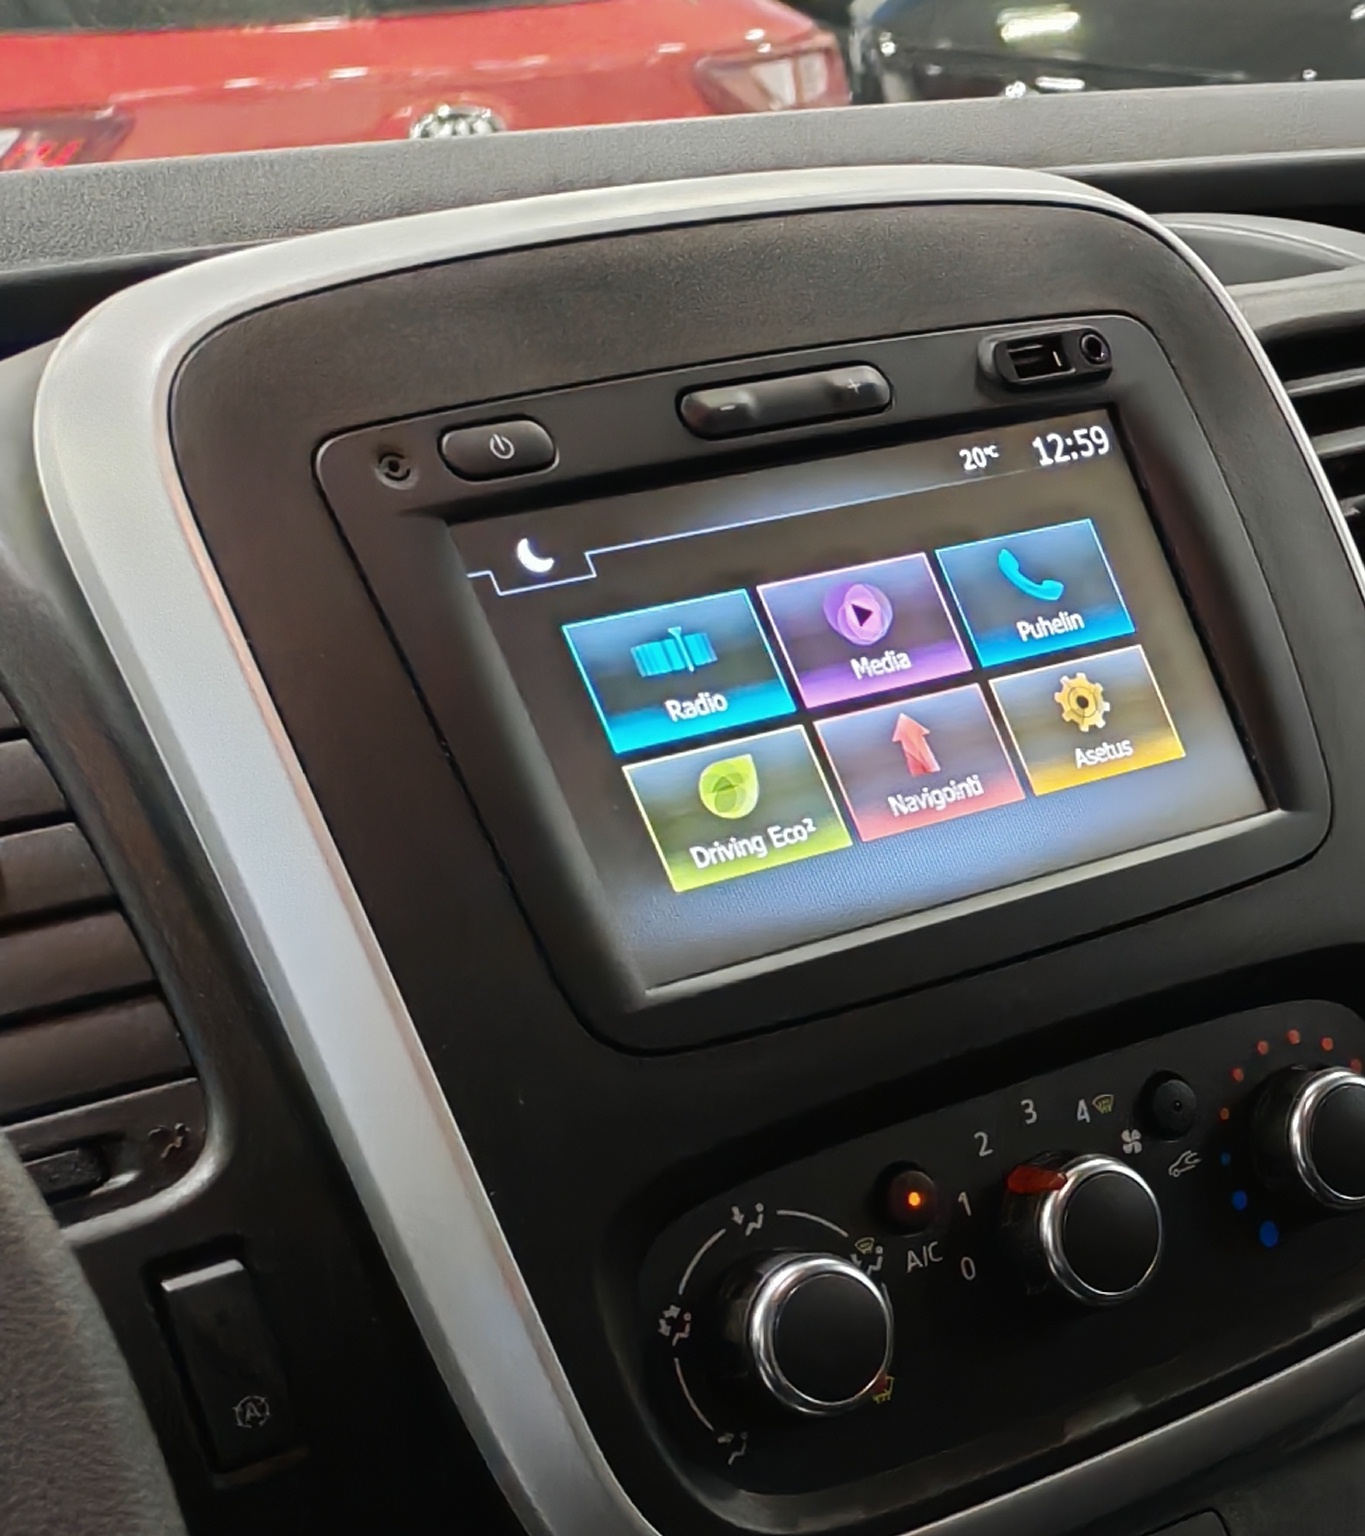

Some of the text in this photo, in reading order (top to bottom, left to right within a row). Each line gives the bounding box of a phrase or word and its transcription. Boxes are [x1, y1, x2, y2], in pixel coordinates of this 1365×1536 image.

[1031, 425, 1110, 467] 12:59
[1016, 611, 1085, 642] Puhelin
[849, 650, 912, 680] Media
[664, 691, 728, 722] Radio
[1074, 738, 1134, 769] Asetus
[887, 774, 985, 817] Navigointi
[689, 833, 769, 870] Driving
[1021, 1099, 1038, 1124] 3
[1076, 1098, 1091, 1124] 4
[973, 1131, 994, 1157] 2
[957, 1191, 972, 1217] 1
[906, 1241, 943, 1274] A/C
[960, 1256, 977, 1281] 0
